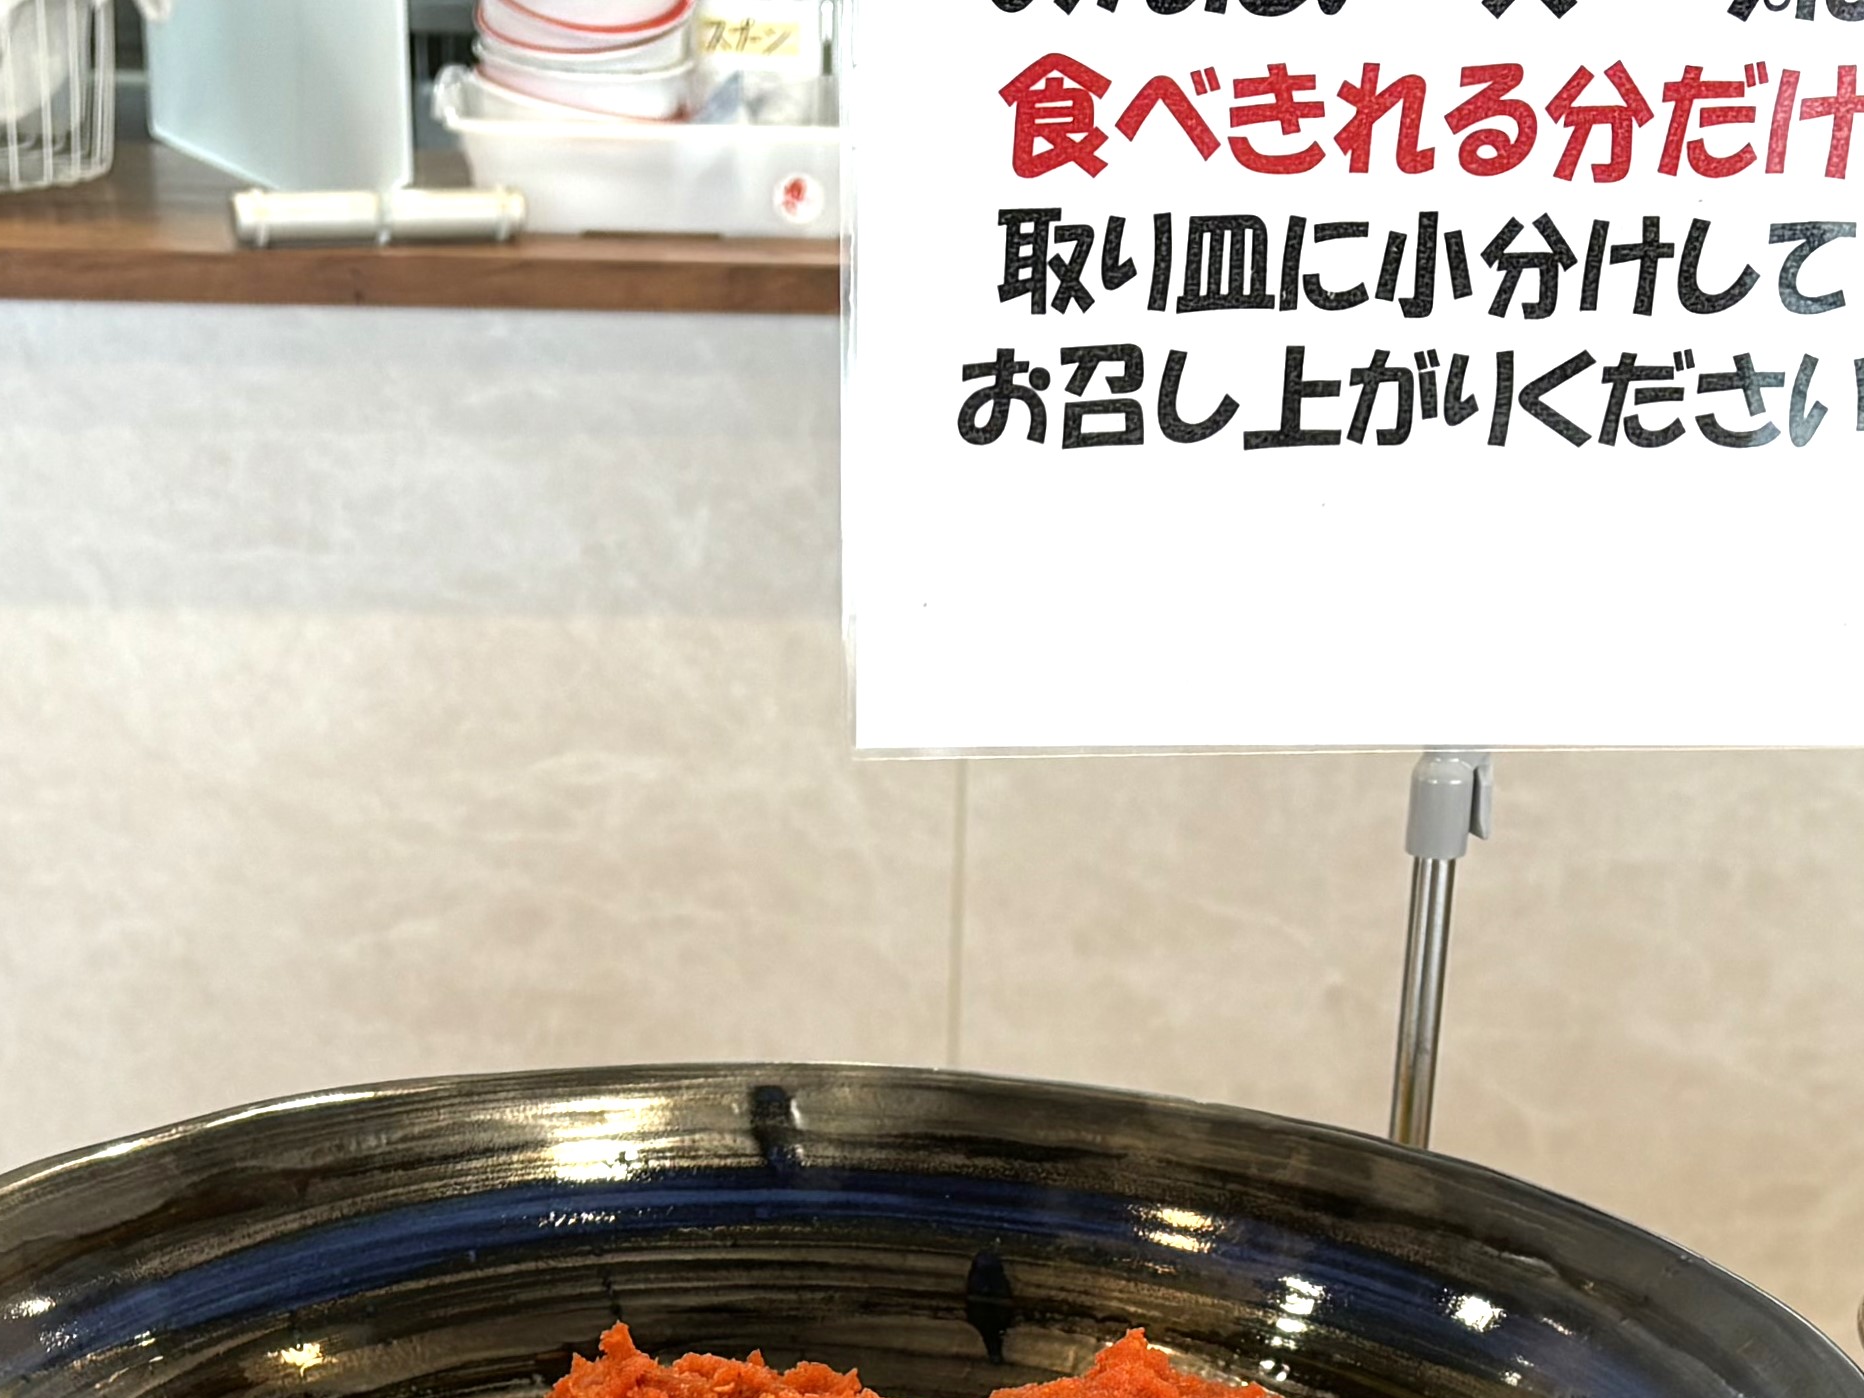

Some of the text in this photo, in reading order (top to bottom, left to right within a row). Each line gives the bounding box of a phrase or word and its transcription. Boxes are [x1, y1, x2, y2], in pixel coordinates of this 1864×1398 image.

[997, 207, 1857, 320] 取り皿に小分けして
